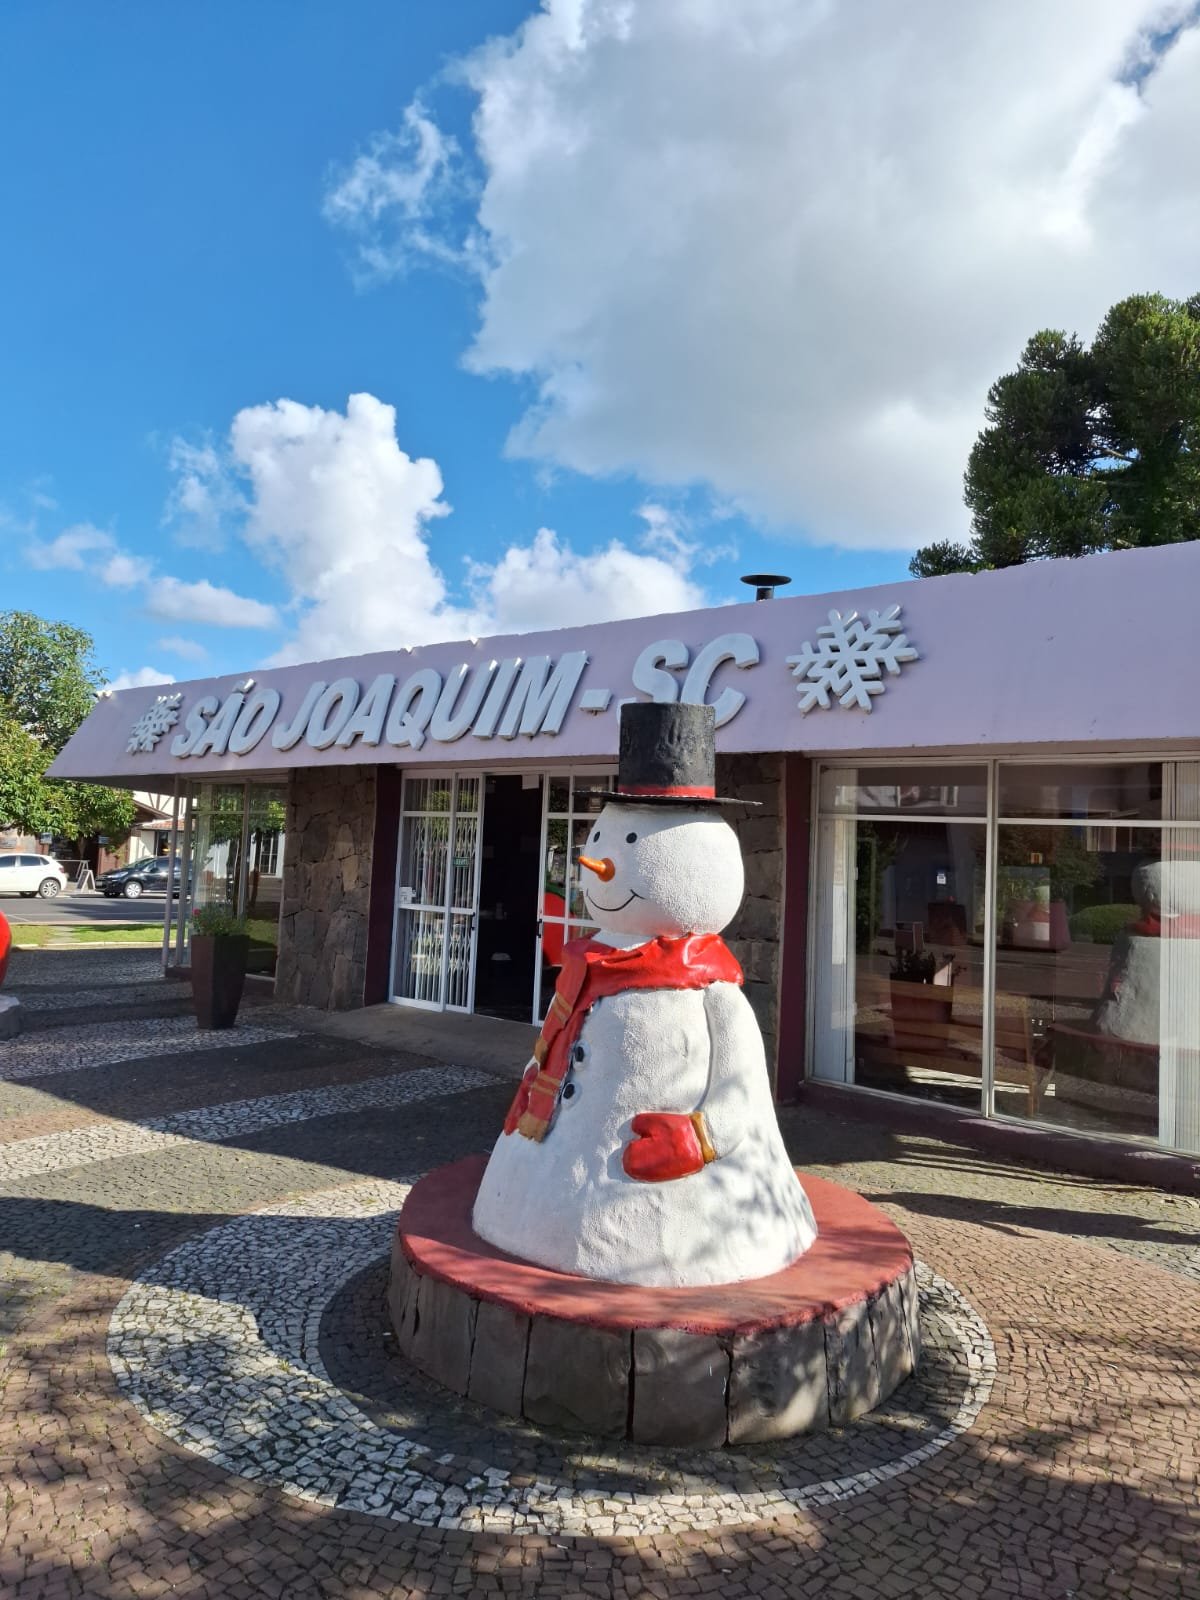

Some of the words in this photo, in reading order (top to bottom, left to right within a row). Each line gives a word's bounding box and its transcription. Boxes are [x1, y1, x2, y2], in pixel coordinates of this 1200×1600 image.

[170, 678, 282, 759] SÃO
[272, 649, 590, 751] JOAQUIM
[616, 632, 760, 729] SC
